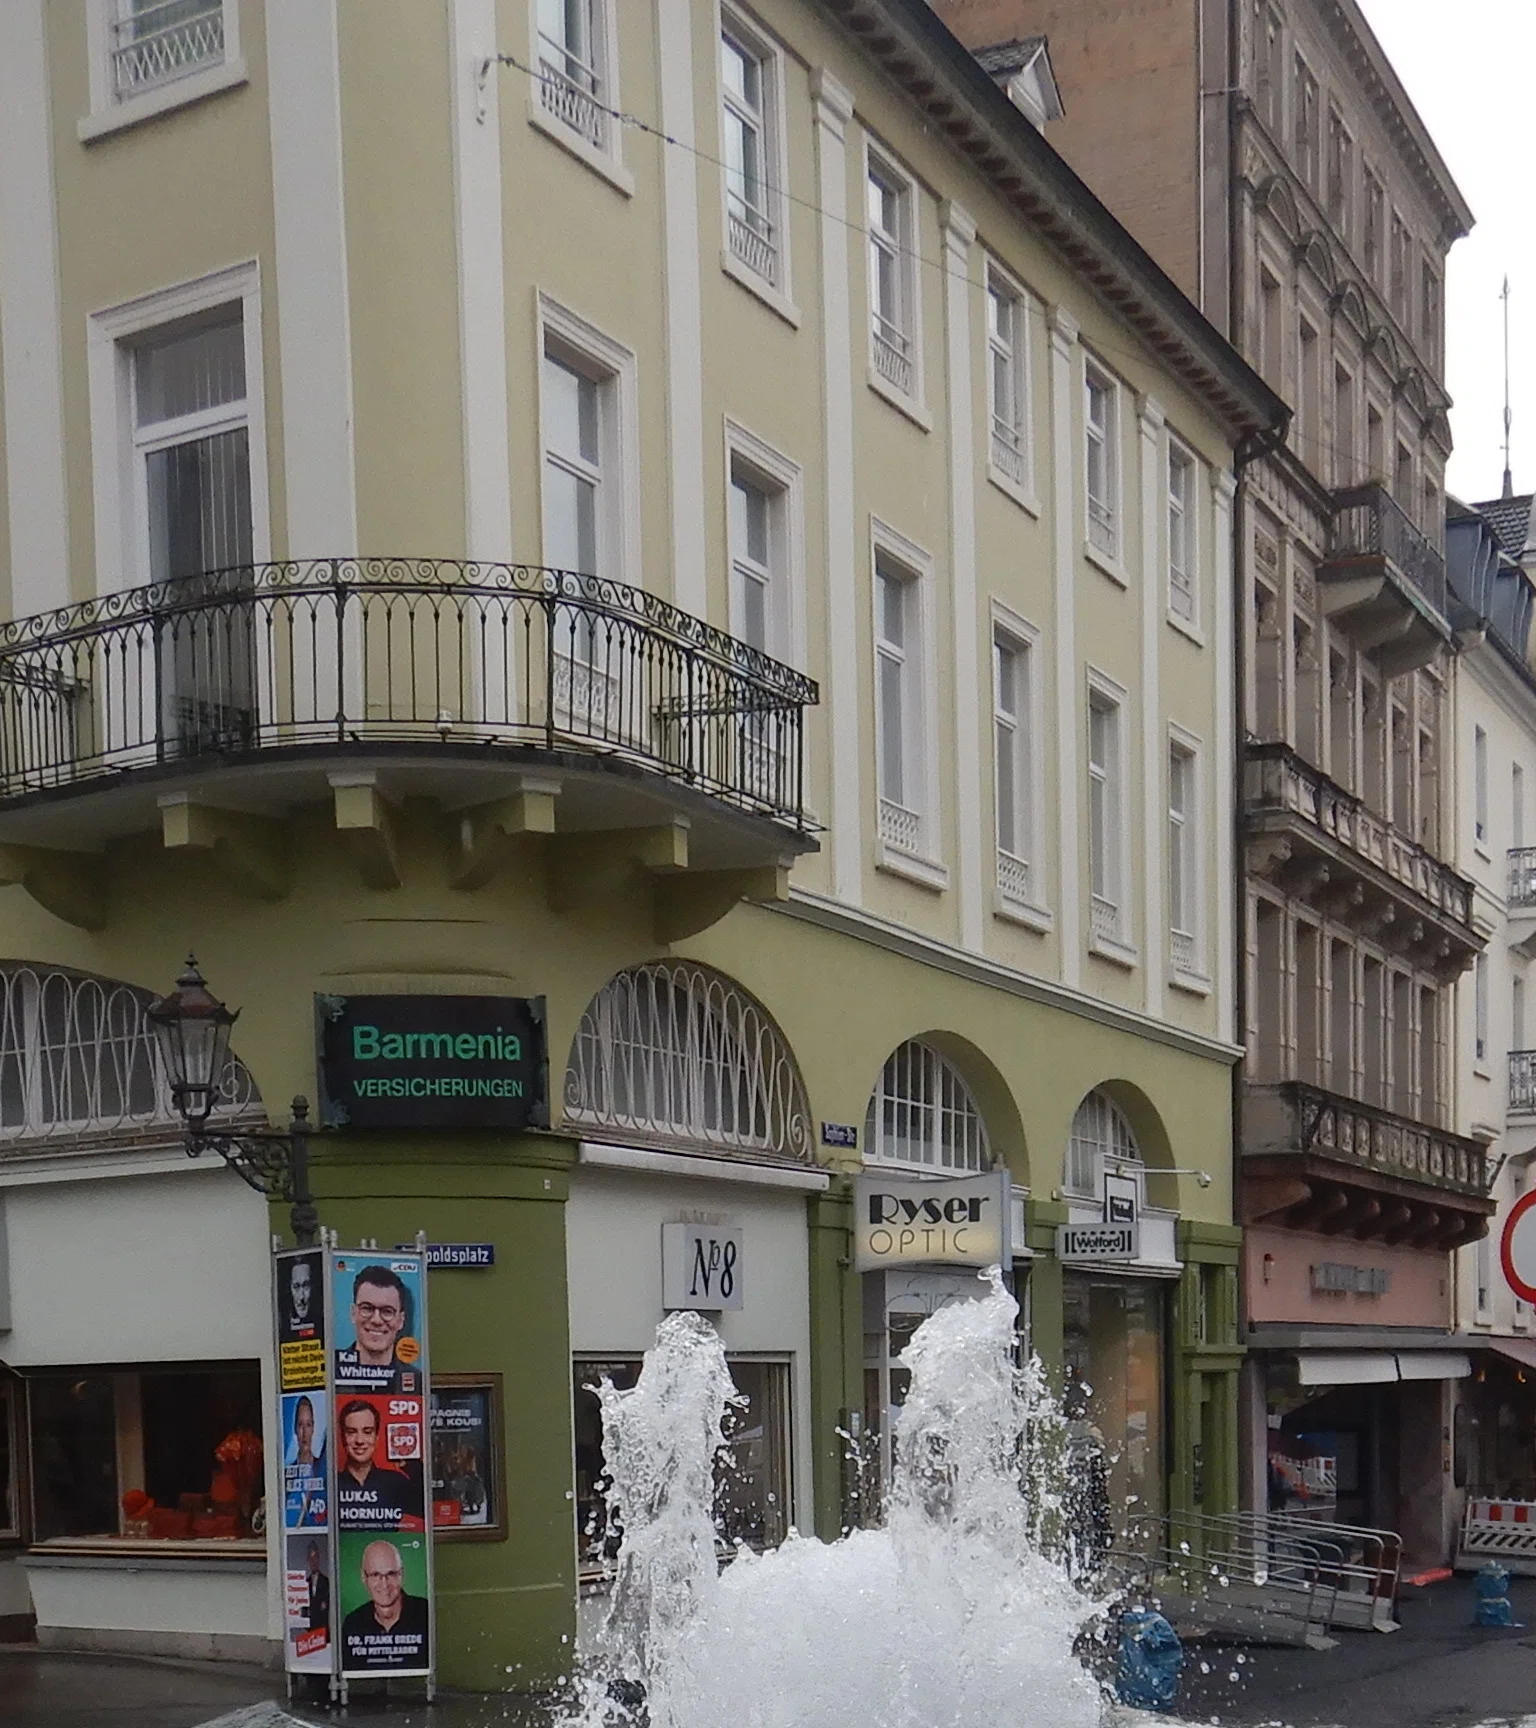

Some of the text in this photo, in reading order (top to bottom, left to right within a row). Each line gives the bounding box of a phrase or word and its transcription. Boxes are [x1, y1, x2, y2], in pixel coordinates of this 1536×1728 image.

[353, 1025, 521, 1060] Barmenia
[353, 1078, 523, 1097] VERSICHERUNGEN
[869, 1194, 989, 1225] Ryser
[869, 1227, 968, 1254] OPTIC
[1076, 1235, 1121, 1249] Wolford
[338, 1352, 358, 1363] Kai
[339, 1366, 395, 1378] Whittaker
[388, 1400, 420, 1415] SPD
[394, 1436, 415, 1446] SPD
[339, 1490, 378, 1503] LUKAS
[340, 1507, 402, 1520] HORNUNG
[364, 1634, 393, 1645] FRANK
